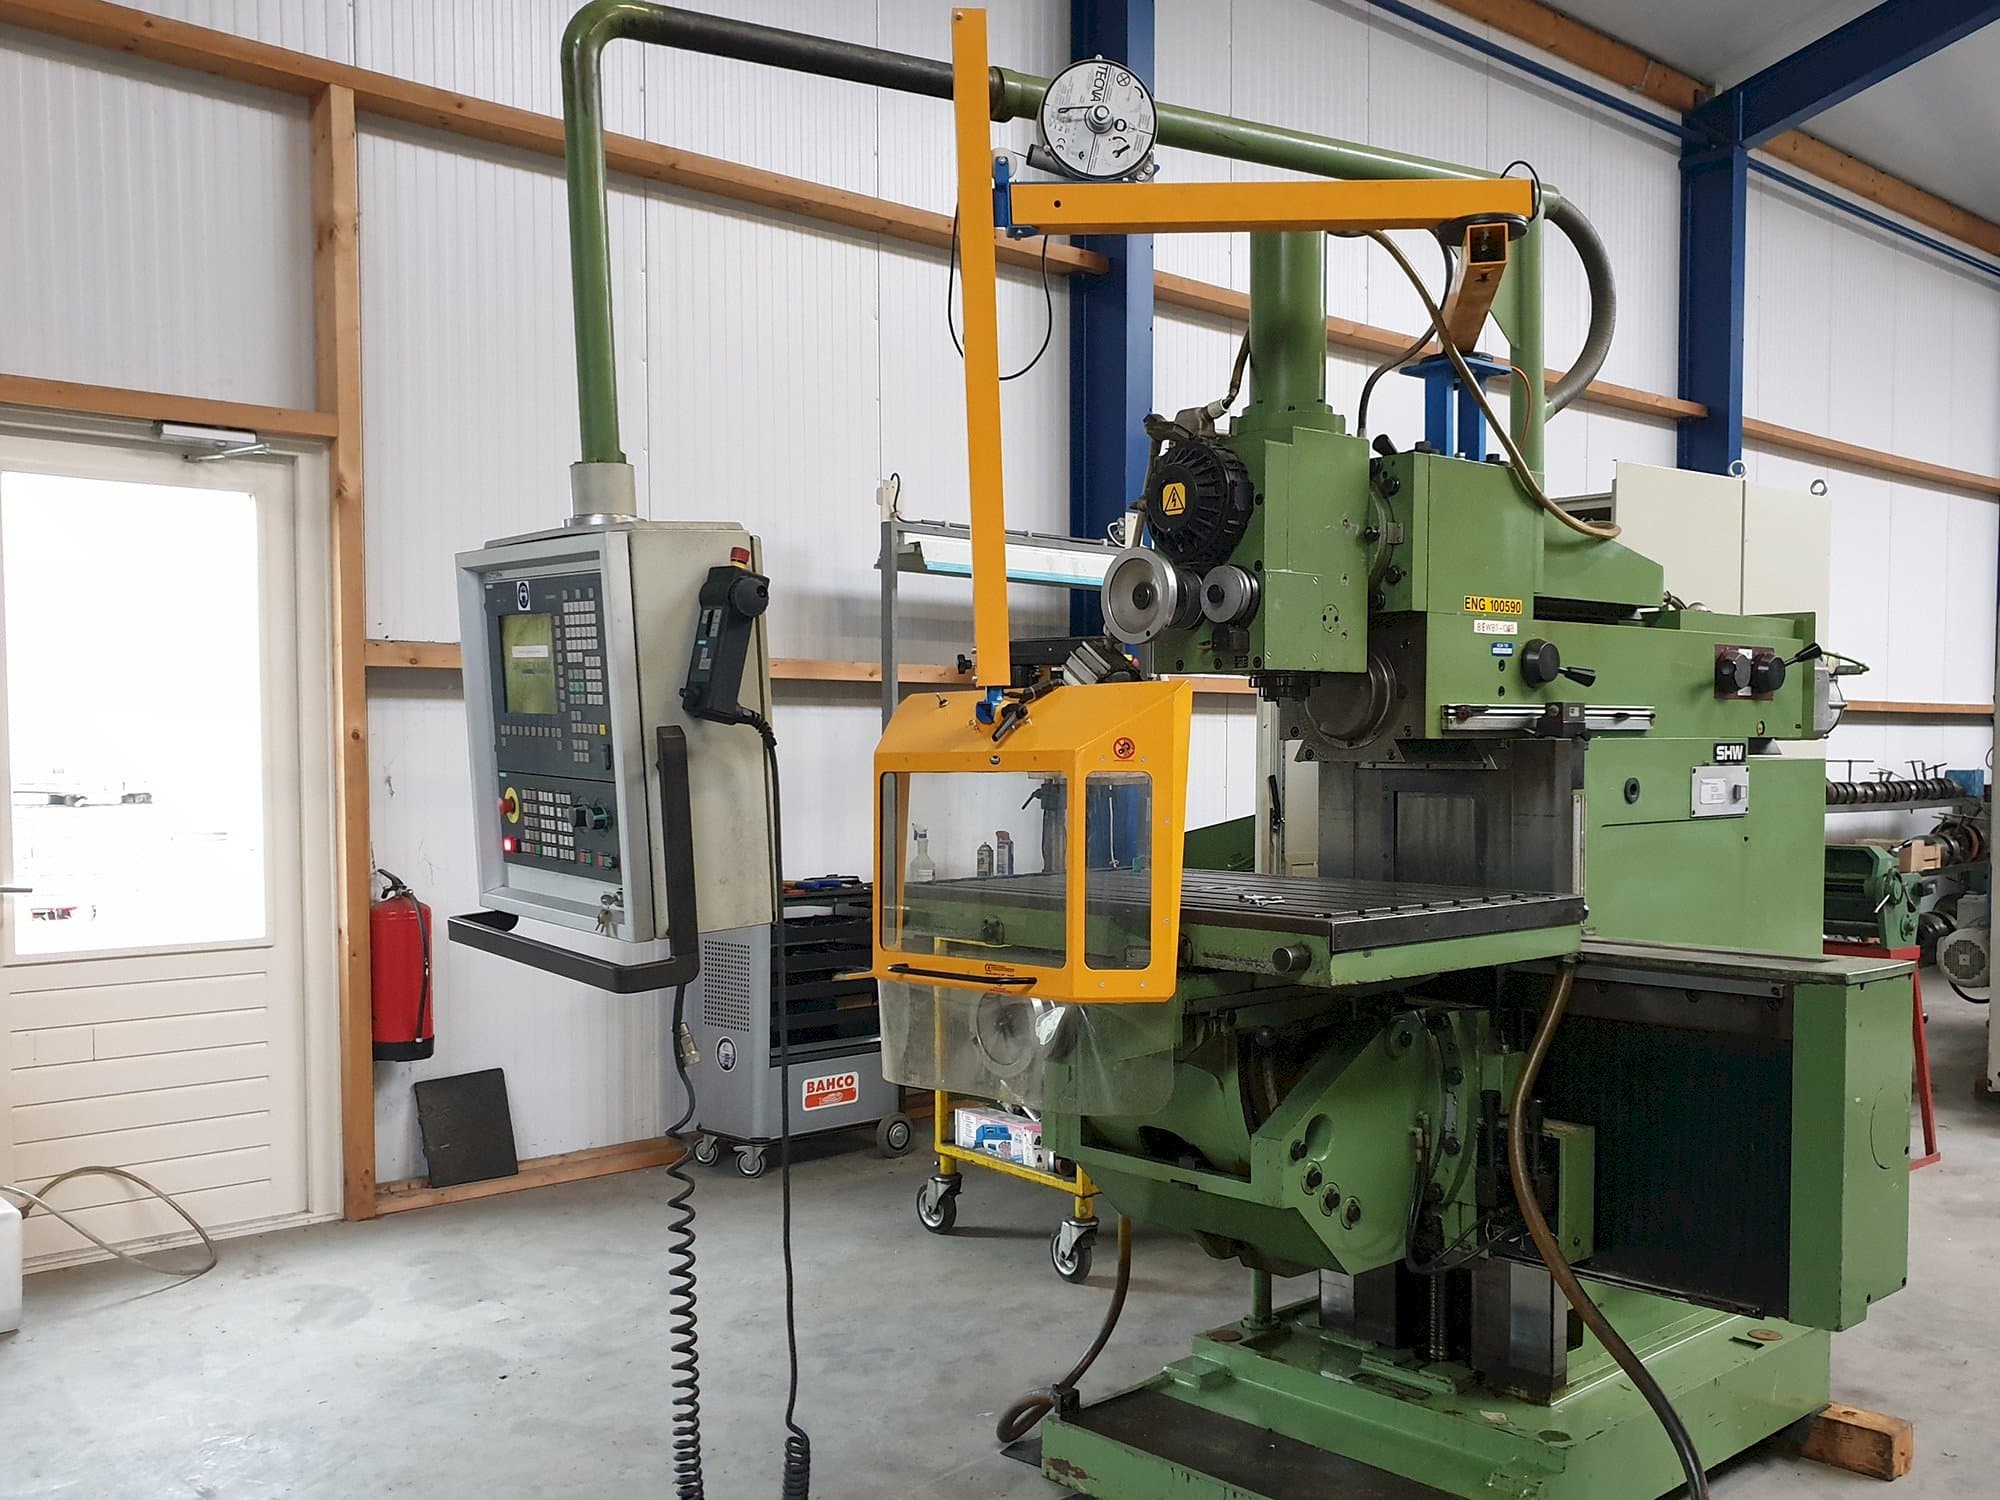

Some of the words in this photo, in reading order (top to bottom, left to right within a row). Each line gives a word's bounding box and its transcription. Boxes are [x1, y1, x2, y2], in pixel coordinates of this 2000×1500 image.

[1090, 65, 1109, 102] TECNA
[1464, 597, 1486, 611] ENG
[1490, 599, 1521, 613] 100590
[1716, 745, 1744, 761] SHW
[806, 1074, 855, 1094] BAHCO
